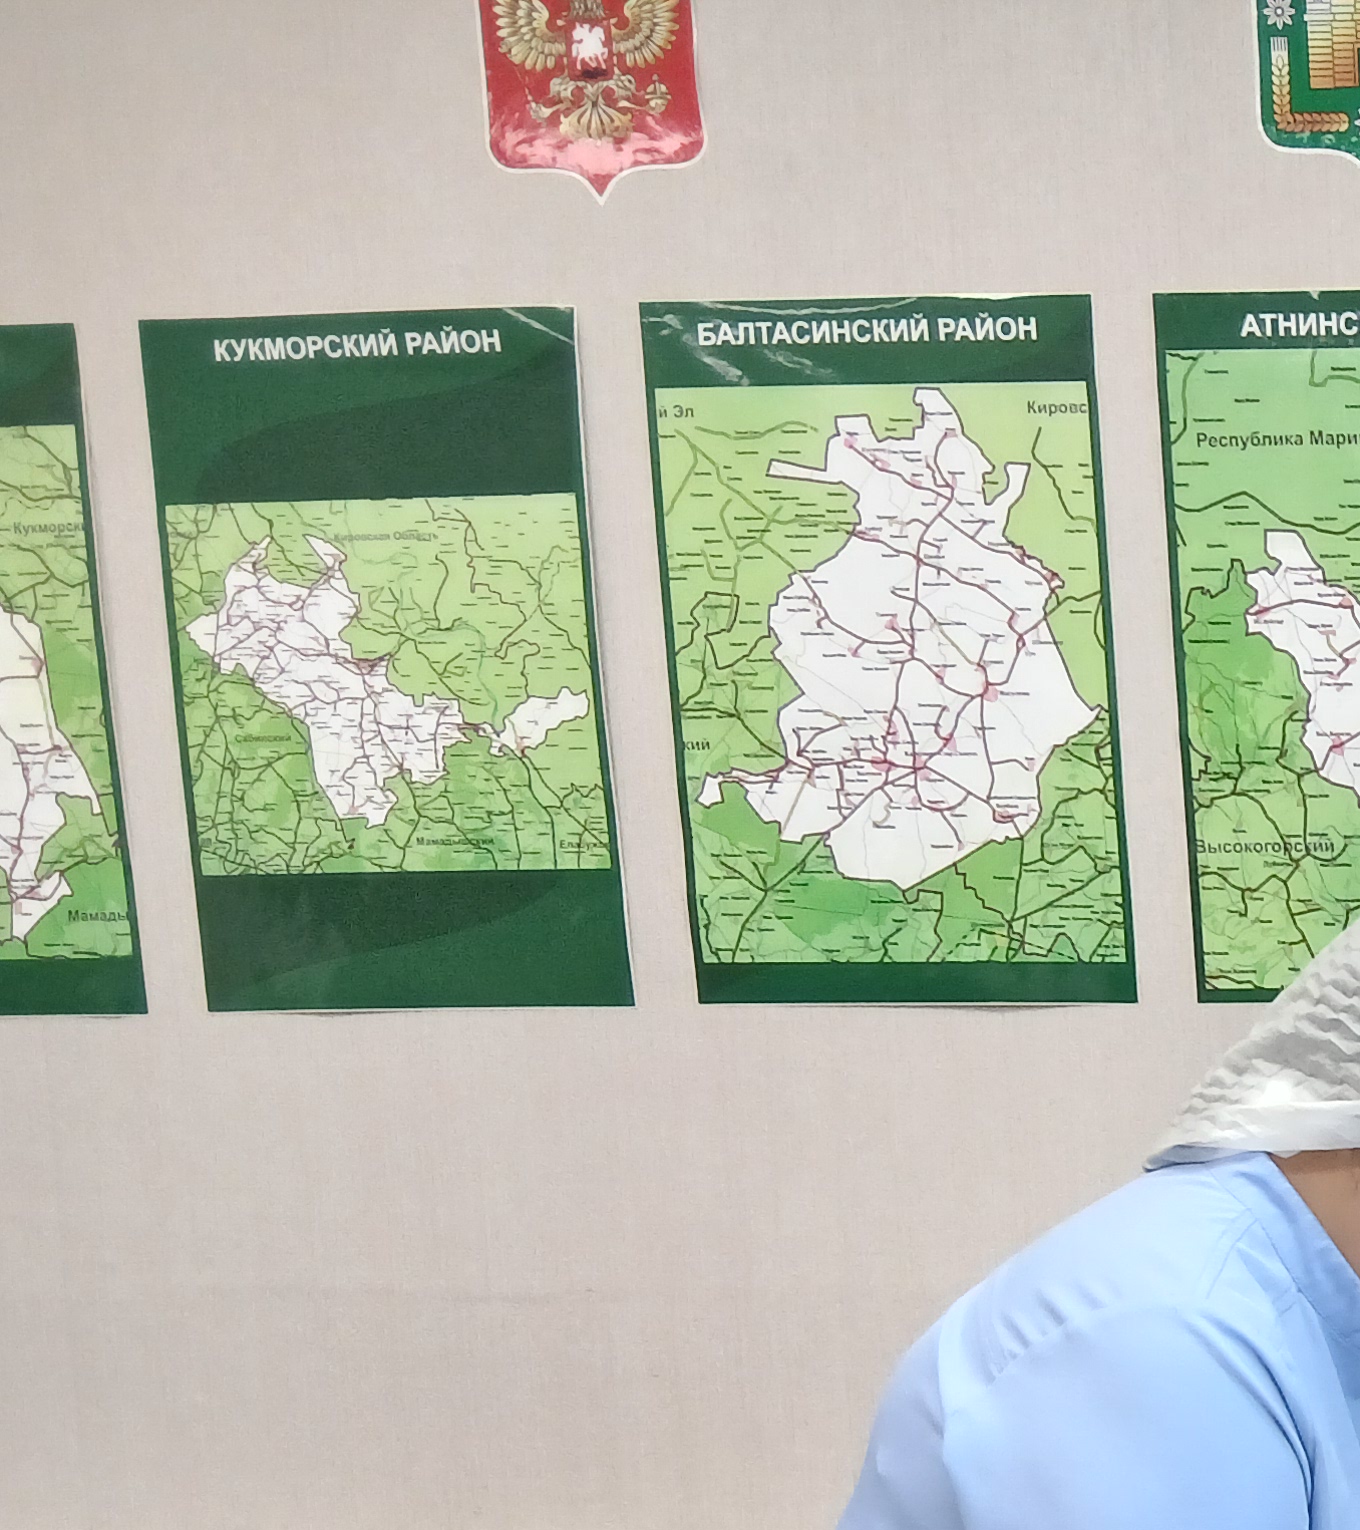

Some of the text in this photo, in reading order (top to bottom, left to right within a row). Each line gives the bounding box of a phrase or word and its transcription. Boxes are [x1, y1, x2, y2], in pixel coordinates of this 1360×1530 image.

[698, 312, 1038, 346] БАЛТАСИНСКИЙ РАЙОН
[213, 325, 502, 362] КУКМОРСКИЙ РАЙОН
[673, 404, 694, 418] Эл
[1196, 431, 1303, 452] Республика
